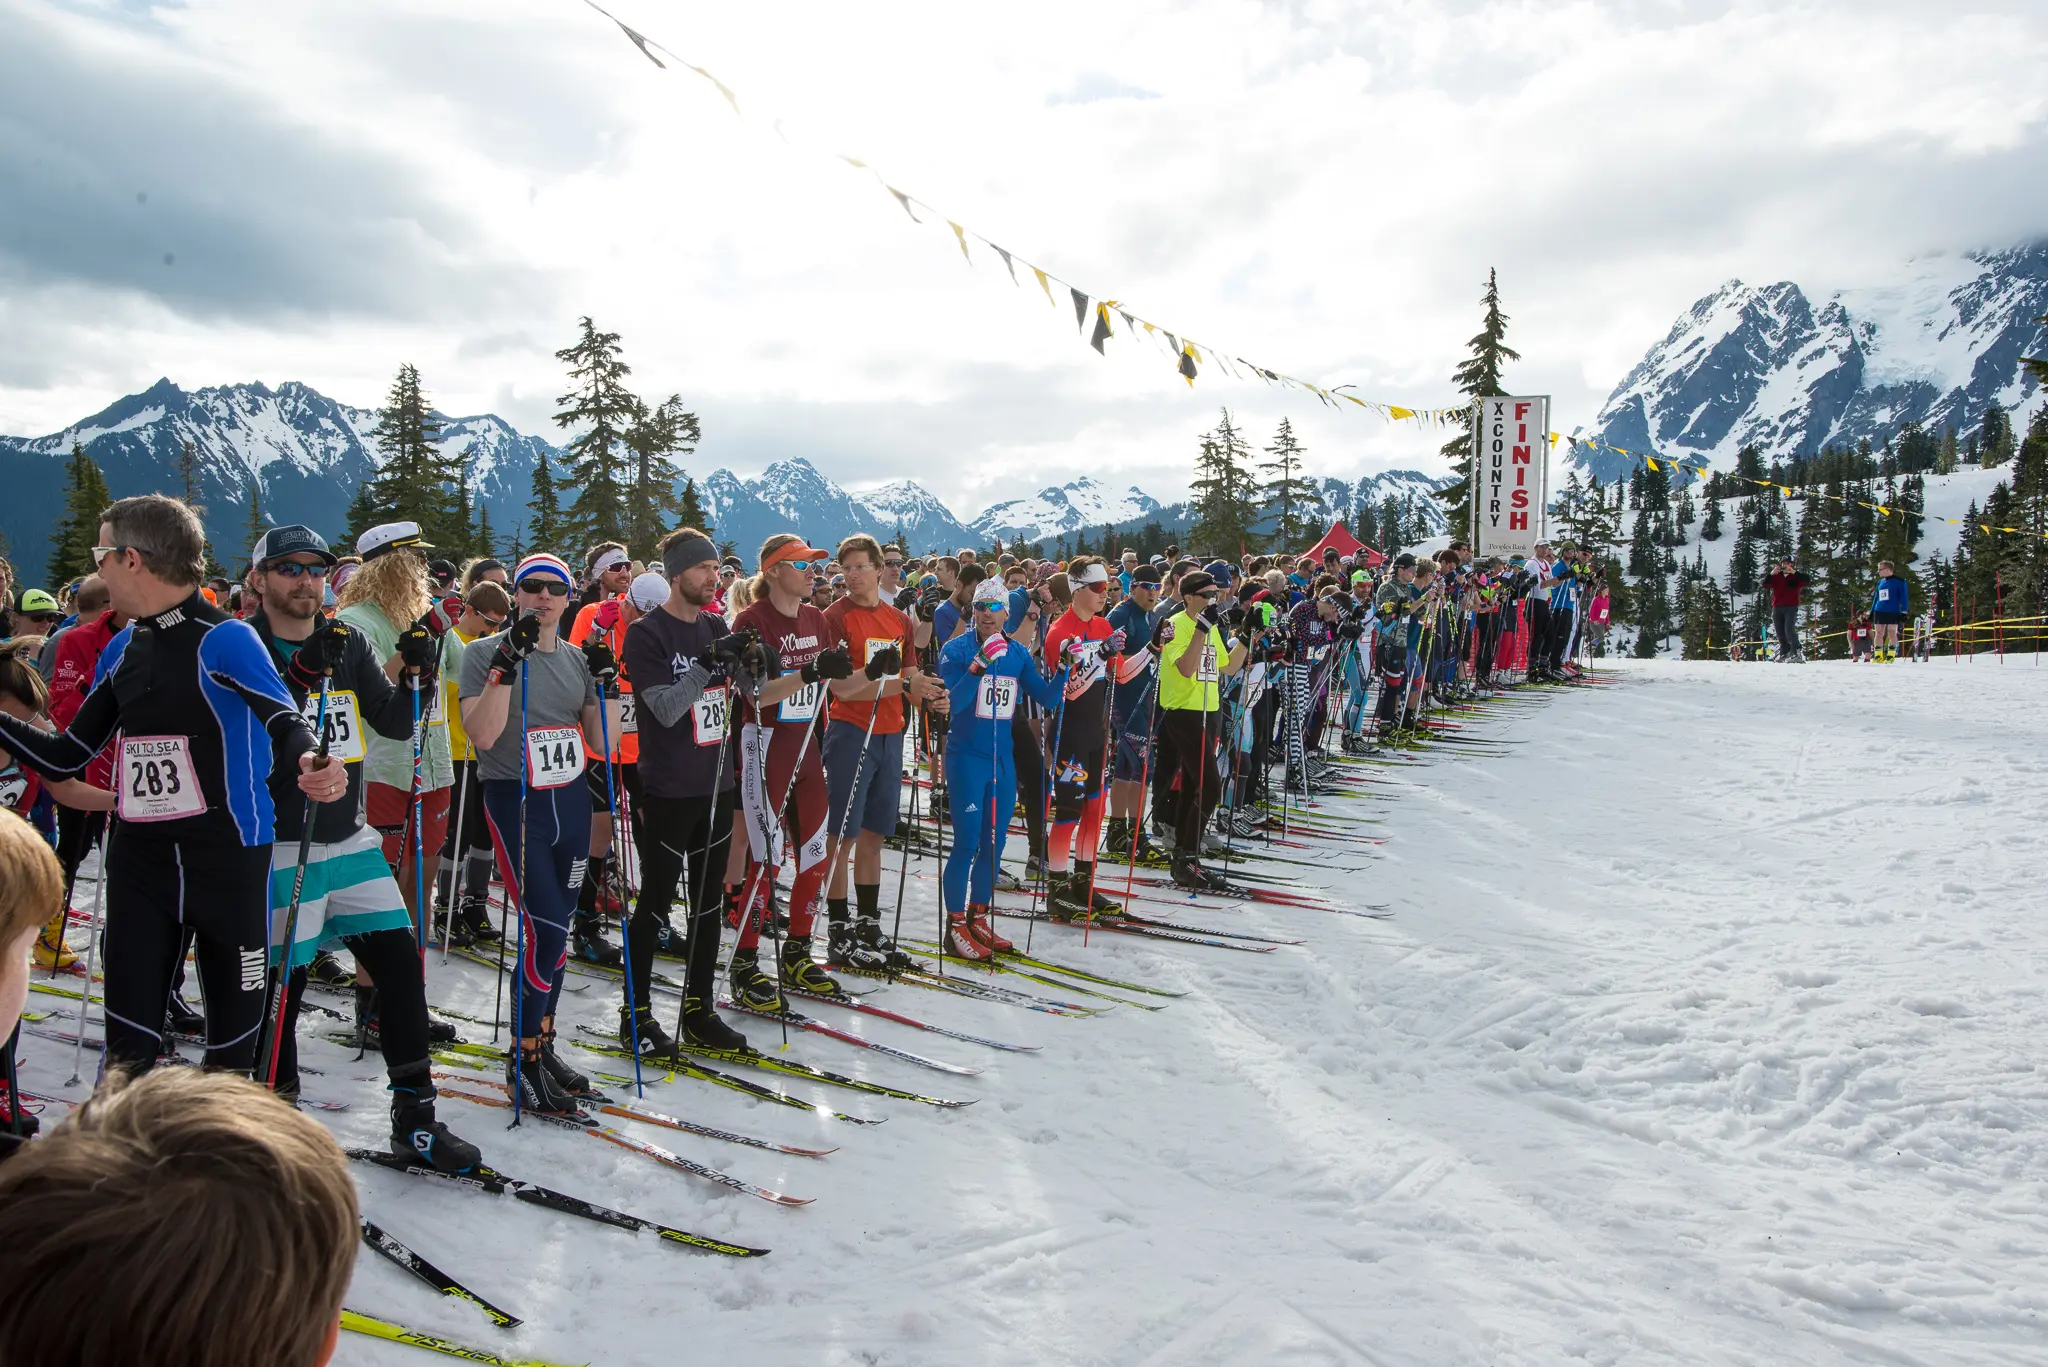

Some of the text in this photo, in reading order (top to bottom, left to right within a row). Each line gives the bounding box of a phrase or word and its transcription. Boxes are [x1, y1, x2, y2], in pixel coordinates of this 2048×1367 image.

[1490, 402, 1504, 528] X-COUNTRY
[1509, 402, 1531, 530] FINISH
[1489, 543, 1512, 551] Peoples
[155, 607, 186, 629] SWIX
[792, 655, 803, 664] THE
[803, 650, 821, 662] CENT
[332, 696, 351, 706] SEA
[530, 732, 546, 741] SKI
[547, 731, 558, 739] TO
[561, 730, 577, 738] SEA
[1124, 732, 1147, 743] CRAFT
[126, 743, 139, 755] SKI
[142, 742, 154, 753] TO
[156, 741, 180, 753] SEA
[538, 741, 576, 772] 144
[131, 759, 180, 797] 283
[567, 858, 587, 888] SWIX
[240, 947, 264, 991] SWIX
[680, 1047, 759, 1066] FISCHER
[416, 1133, 430, 1149] S
[660, 1230, 749, 1256] FISCHER
